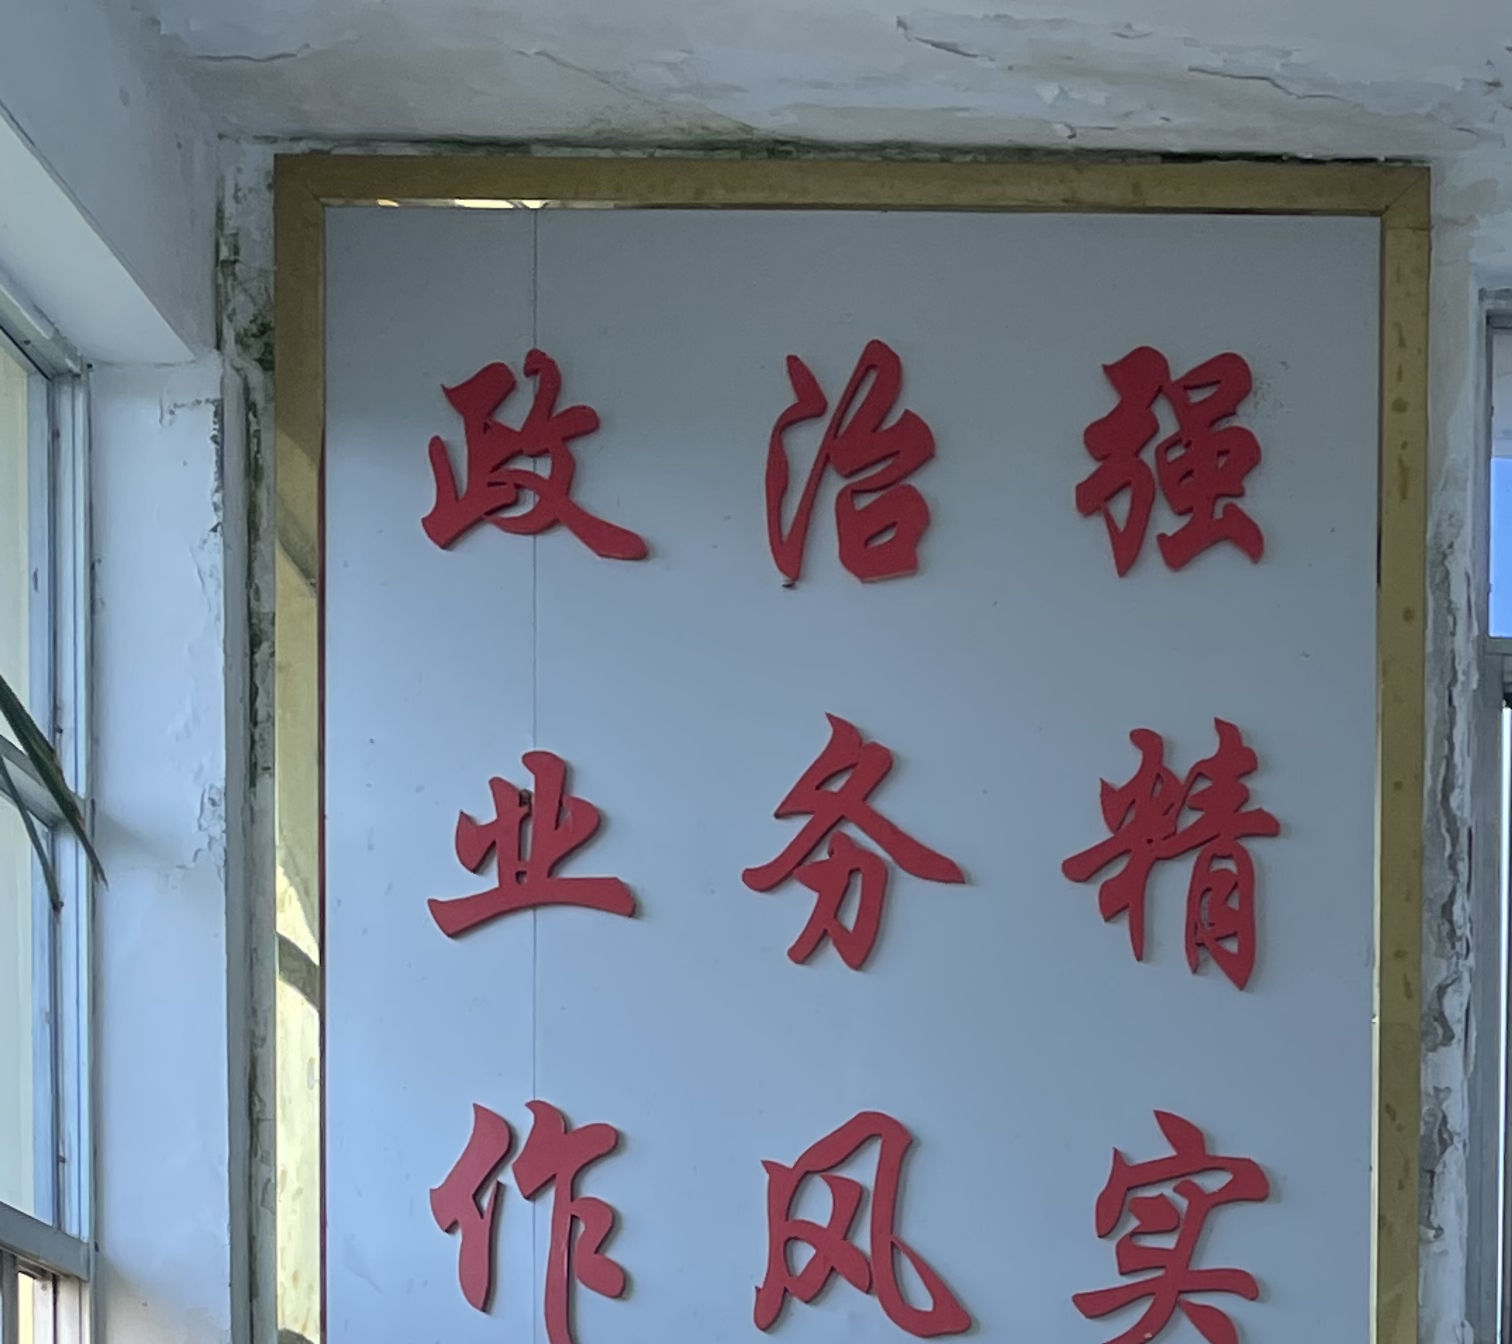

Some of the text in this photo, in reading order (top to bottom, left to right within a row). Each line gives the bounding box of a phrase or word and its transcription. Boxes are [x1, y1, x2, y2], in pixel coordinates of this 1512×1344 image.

[422, 340, 1265, 581] 政治强
[429, 715, 1280, 987] 业务精
